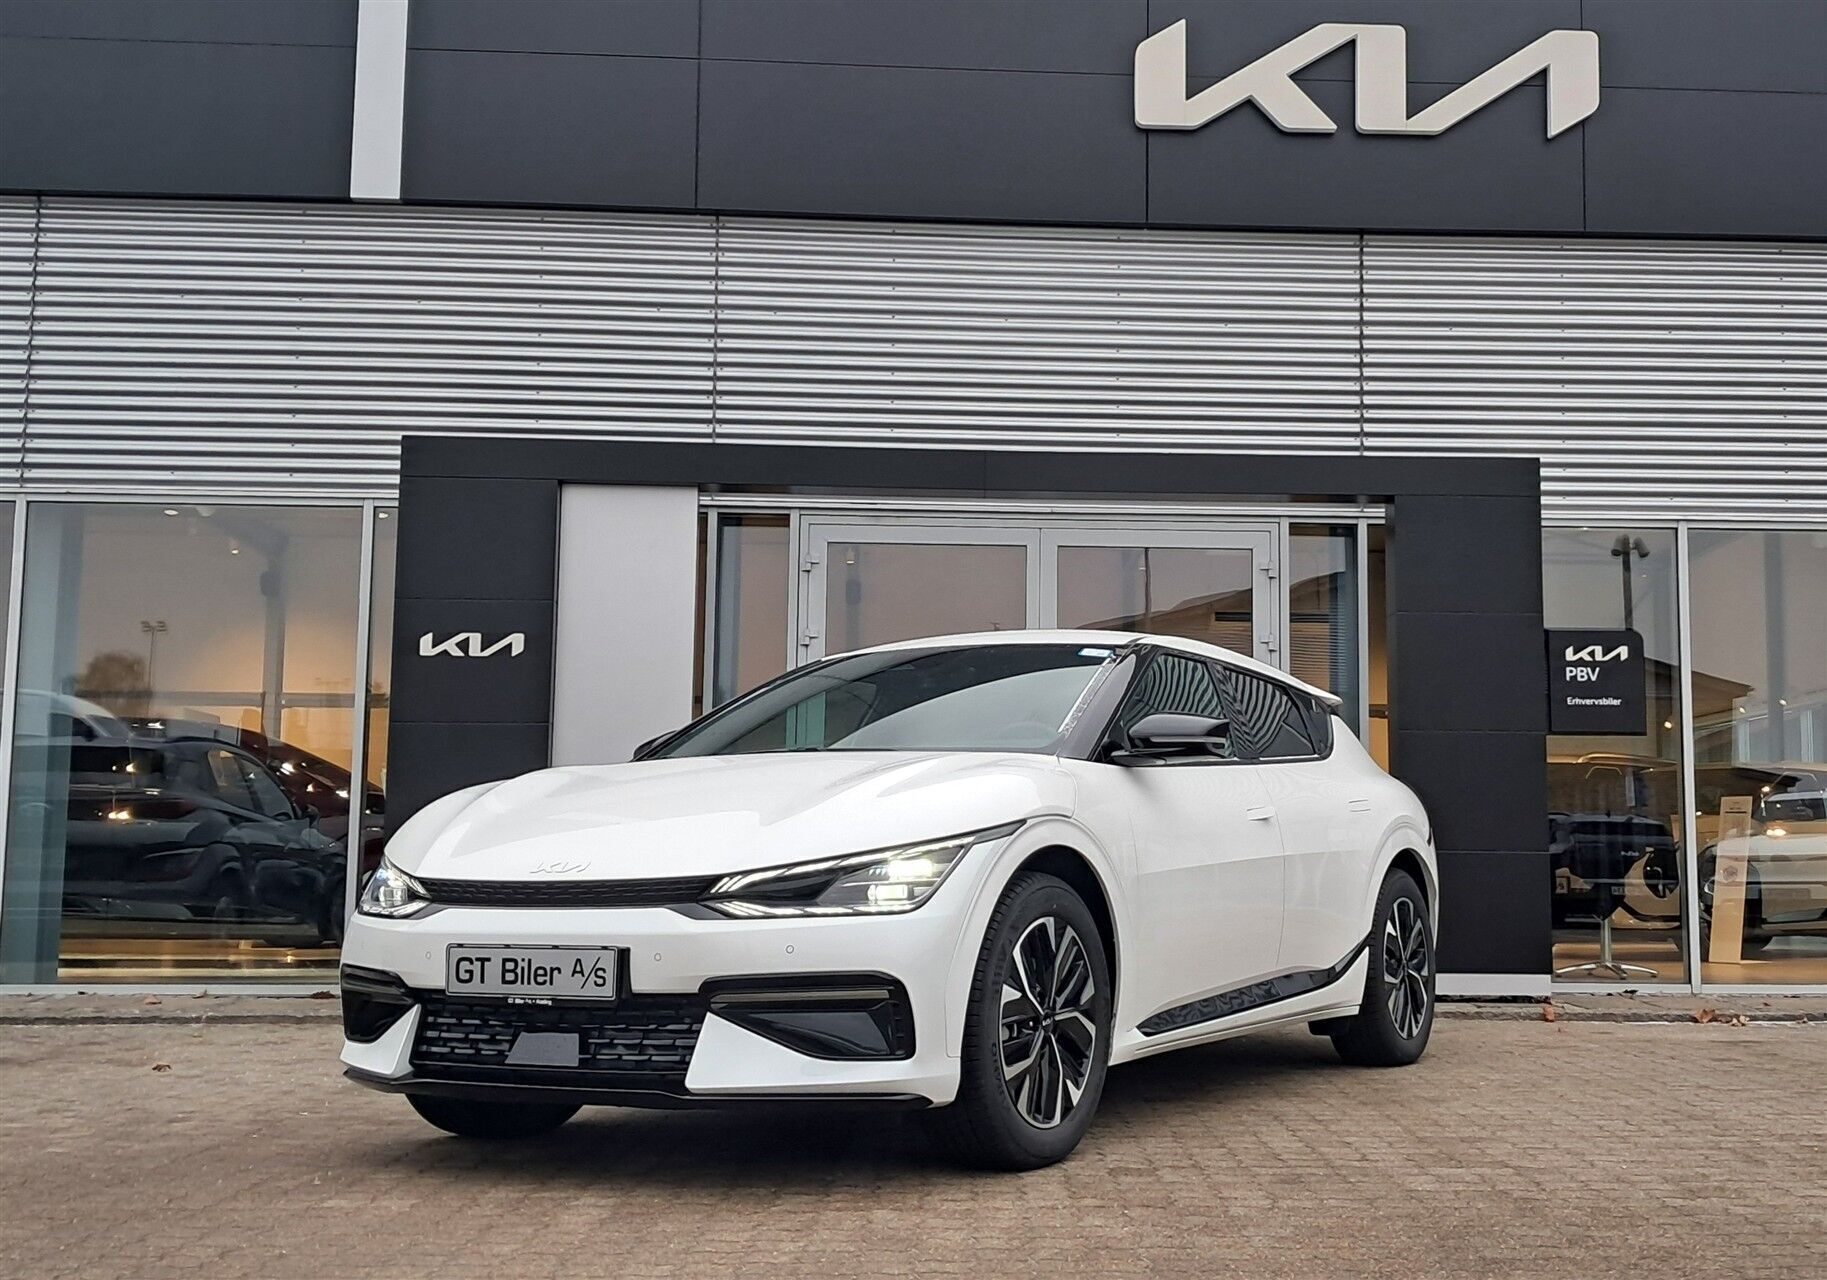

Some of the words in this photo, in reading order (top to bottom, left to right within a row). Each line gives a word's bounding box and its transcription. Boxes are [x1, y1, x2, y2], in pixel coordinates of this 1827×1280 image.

[1134, 18, 1601, 139] KIA
[419, 632, 525, 657] KIA
[1565, 645, 1629, 662] KIA
[1565, 666, 1600, 682] PBV
[1566, 696, 1622, 706] Erhvervsbiler
[455, 956, 492, 985] GT
[501, 957, 562, 986] Biler
[571, 956, 607, 990] A/S
